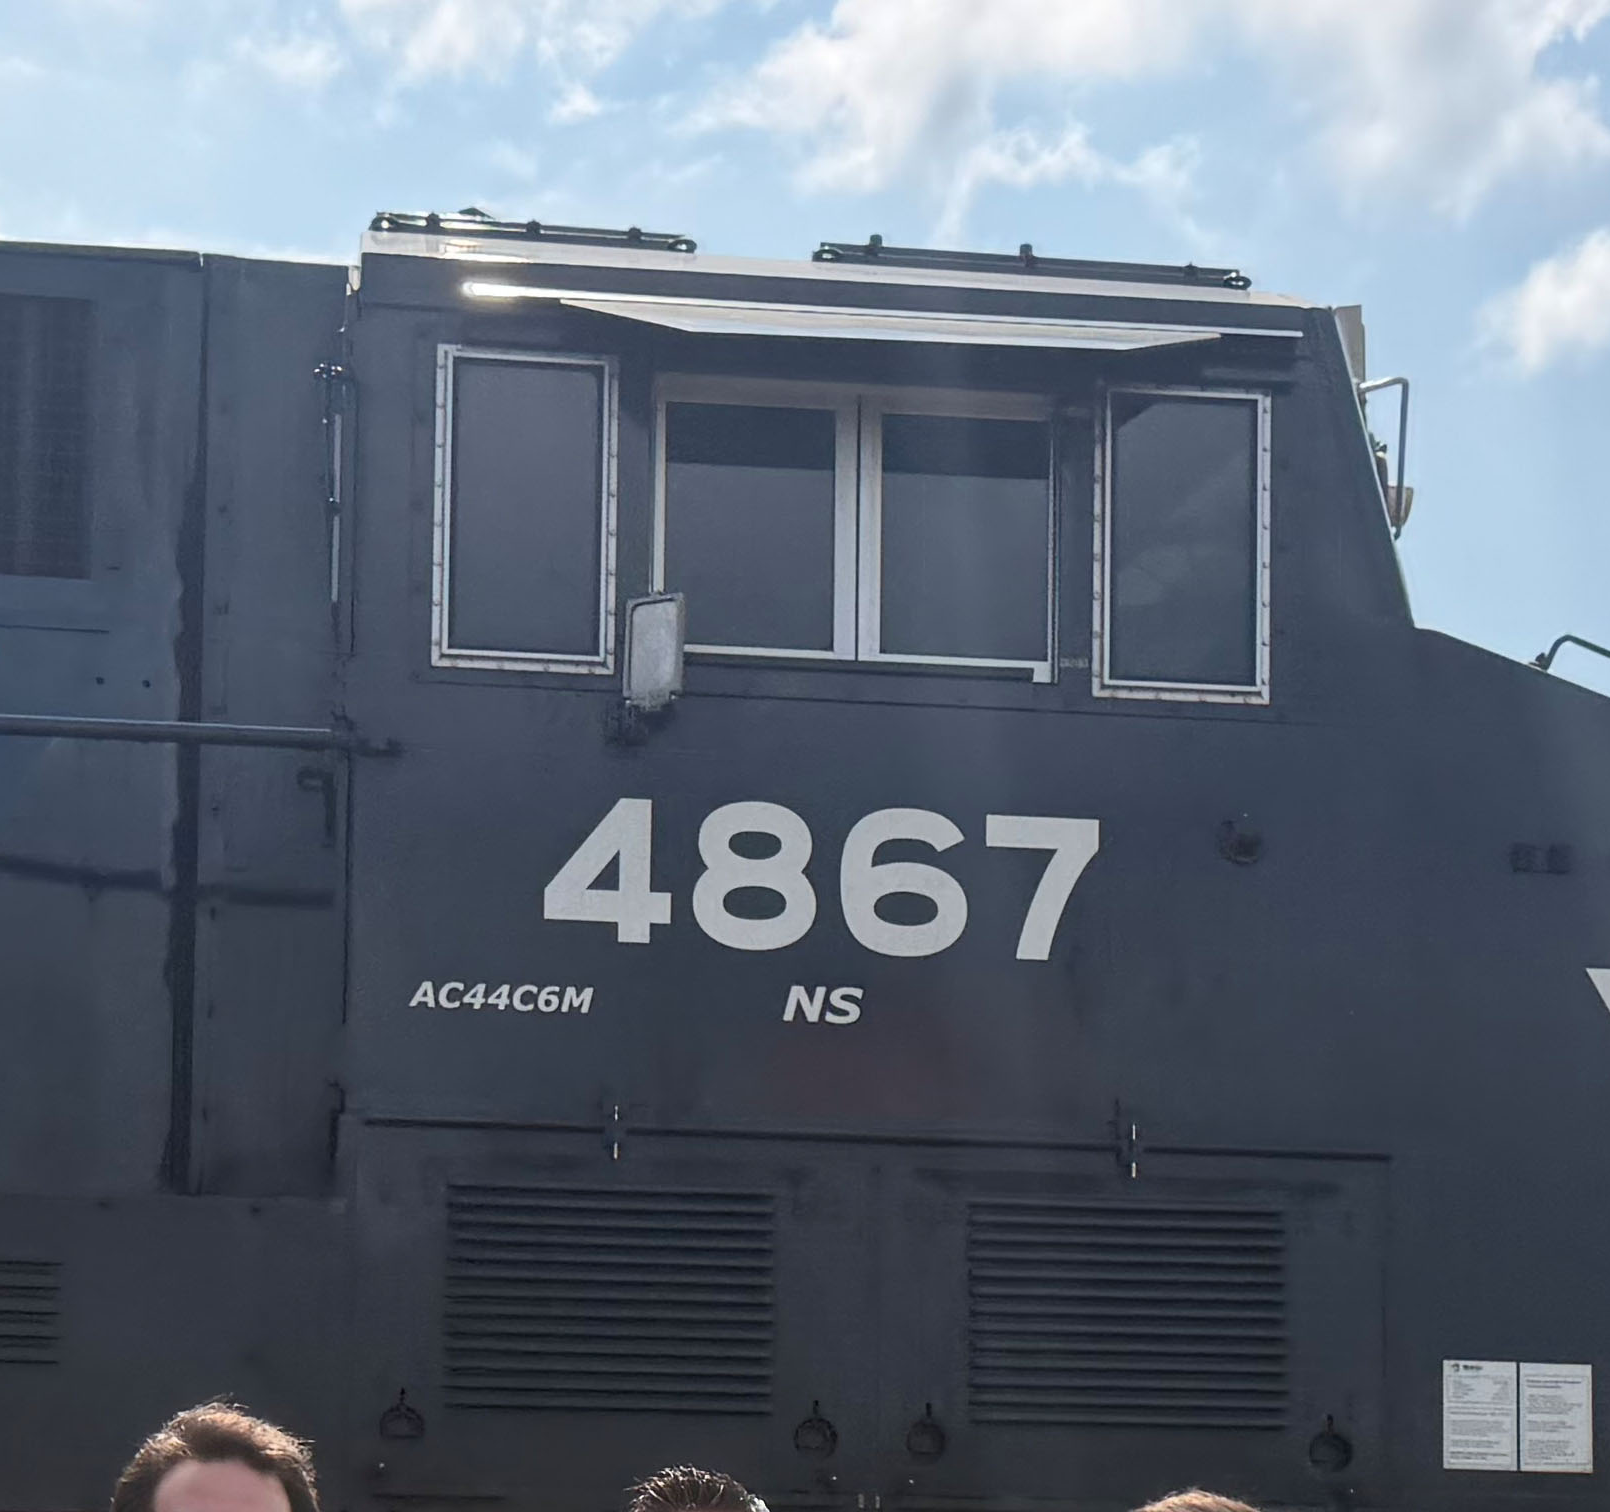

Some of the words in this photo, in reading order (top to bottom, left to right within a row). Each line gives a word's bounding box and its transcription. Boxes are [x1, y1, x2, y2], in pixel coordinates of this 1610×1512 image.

[543, 797, 1101, 961] 4867
[409, 980, 595, 1014] AC44C6M
[782, 985, 865, 1025] NS
